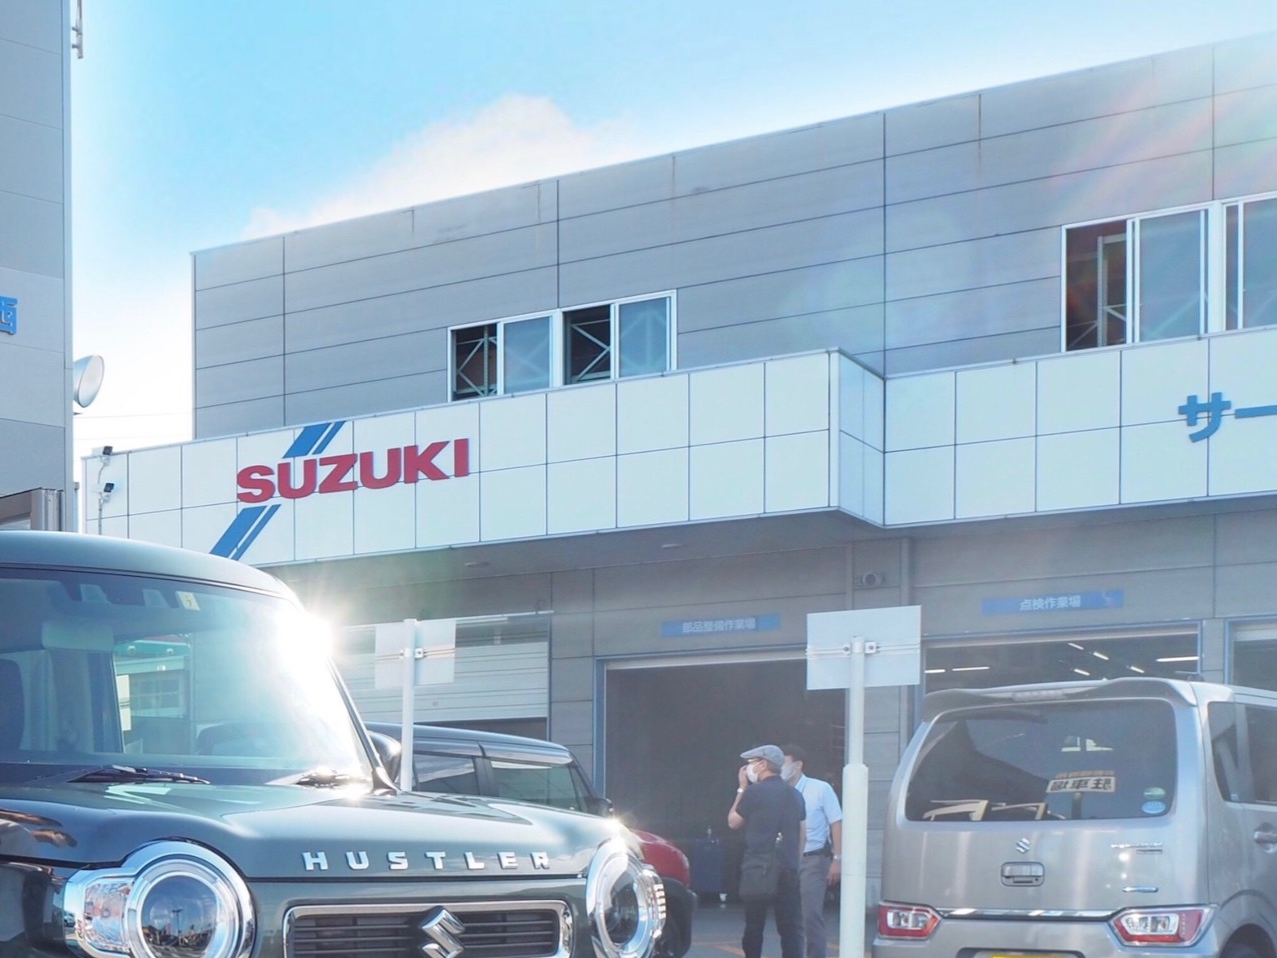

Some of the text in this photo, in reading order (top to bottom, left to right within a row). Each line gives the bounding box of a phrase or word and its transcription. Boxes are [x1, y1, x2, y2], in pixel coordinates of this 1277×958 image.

[237, 438, 470, 503] SUZUKI
[1020, 595, 1081, 611] 点検作業場
[302, 851, 550, 871] HUSTLER
